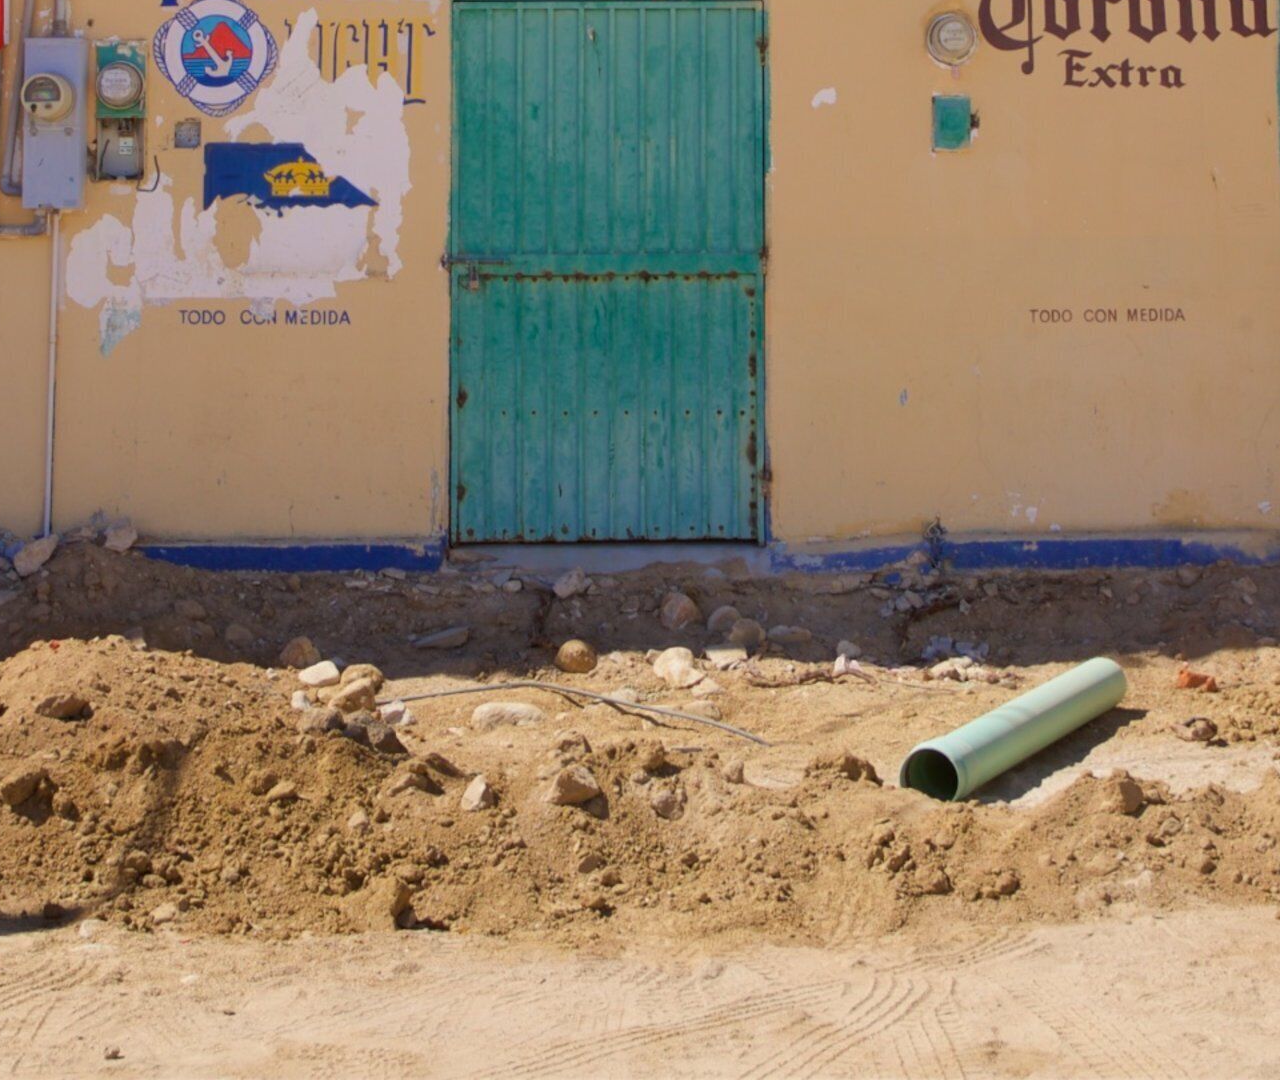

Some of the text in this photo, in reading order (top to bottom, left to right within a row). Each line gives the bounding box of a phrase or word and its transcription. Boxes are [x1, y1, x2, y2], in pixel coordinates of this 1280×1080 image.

[1057, 49, 1186, 89] Extra
[178, 309, 226, 325] TODO
[285, 309, 351, 325] MEDIDA
[1029, 308, 1186, 323] TODO CON MEDIDA
